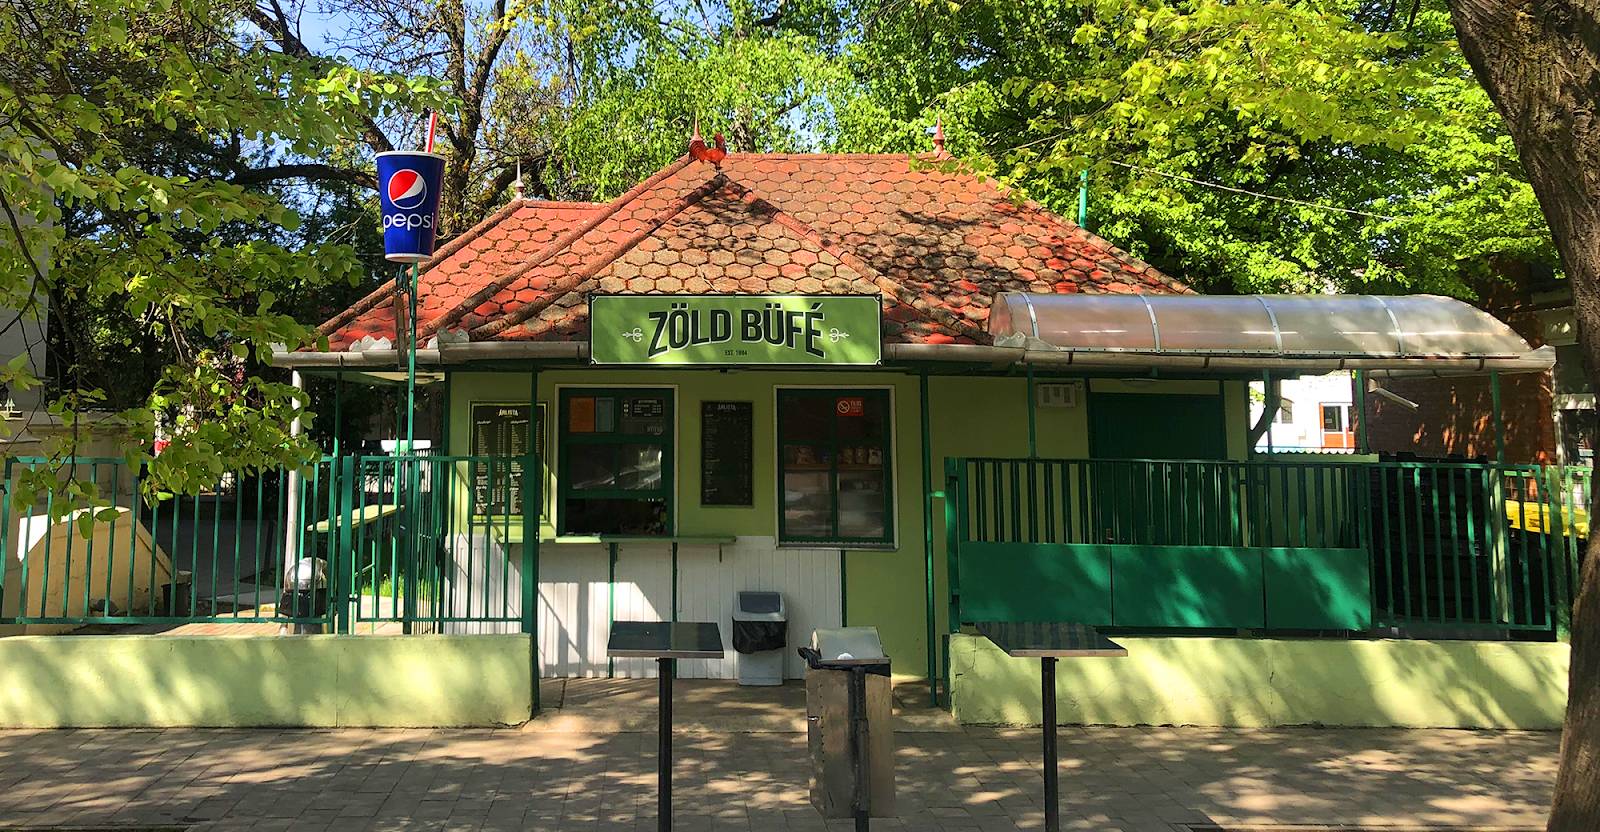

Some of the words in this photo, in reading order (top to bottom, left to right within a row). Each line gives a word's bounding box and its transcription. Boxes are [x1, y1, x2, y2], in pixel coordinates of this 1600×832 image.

[383, 212, 434, 232] pepsi
[648, 303, 732, 359] ZÖLD
[741, 303, 825, 359] BÜFÉ
